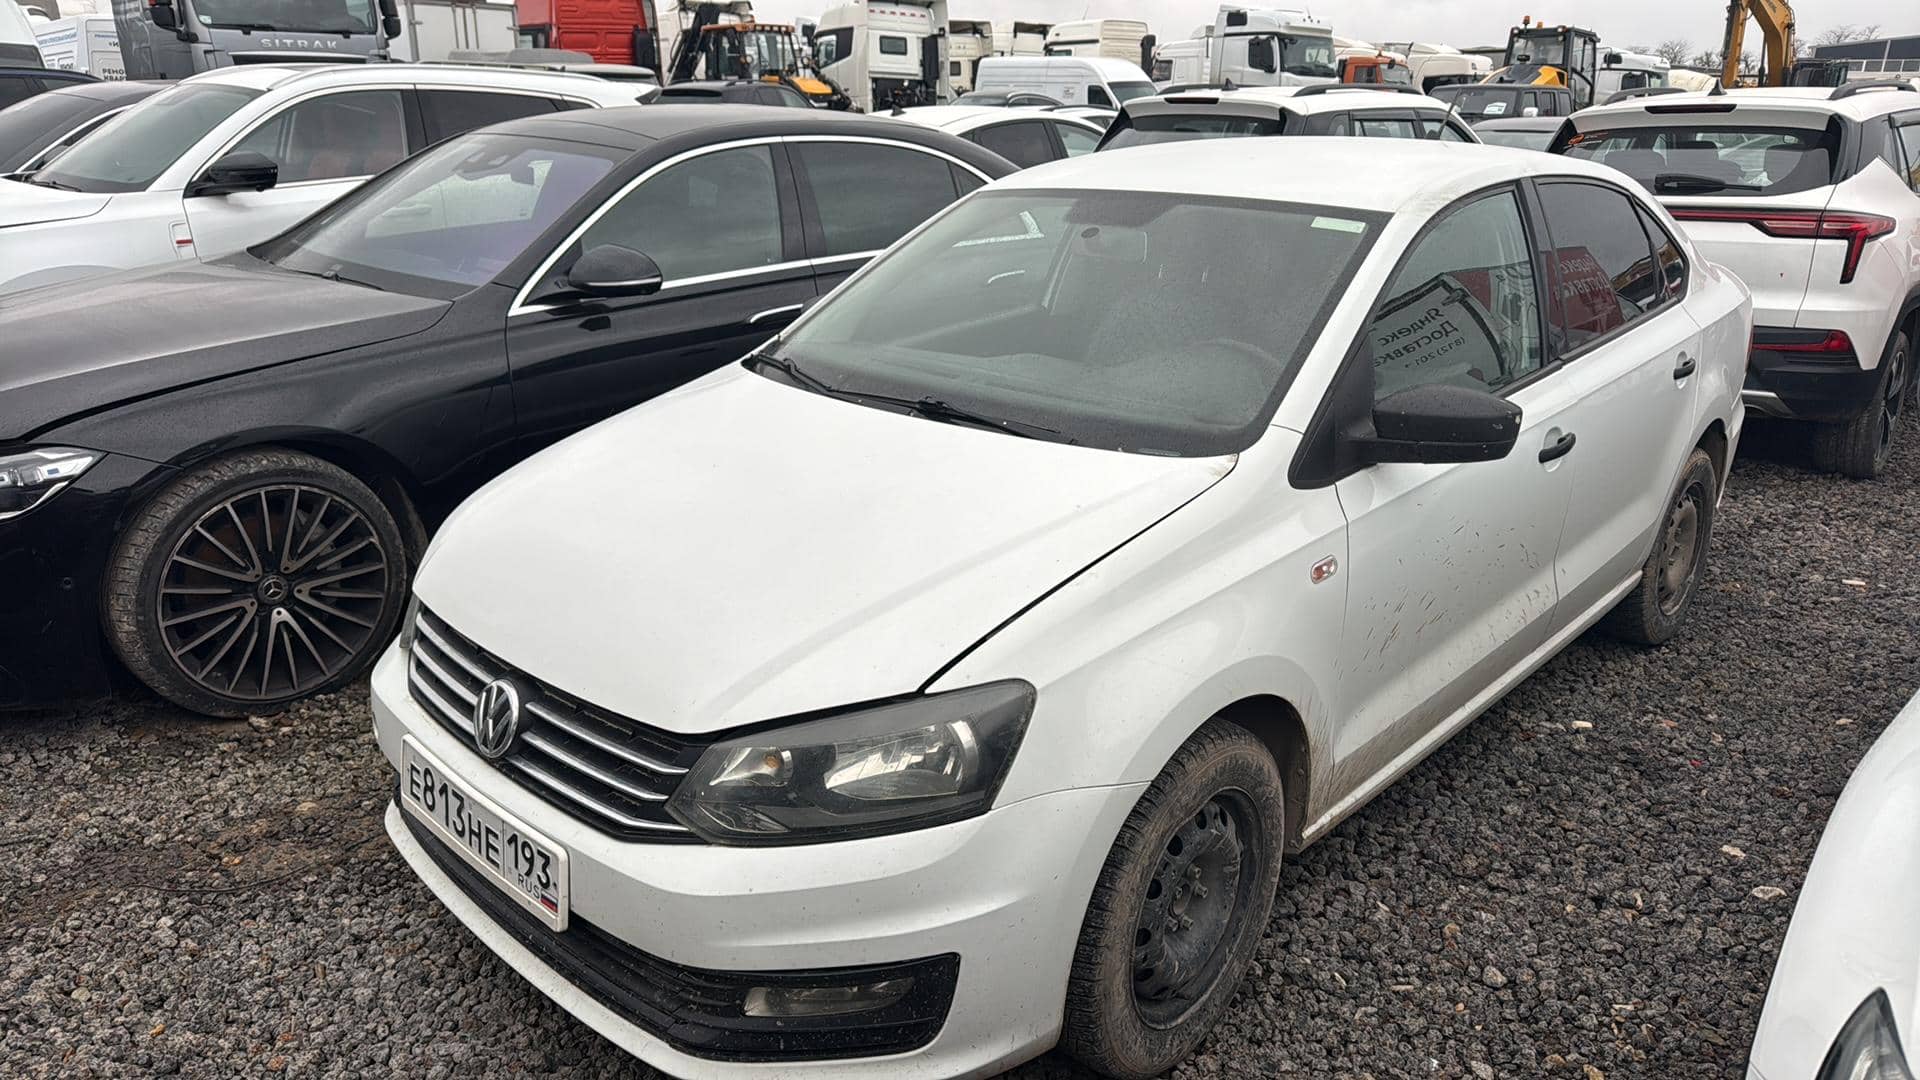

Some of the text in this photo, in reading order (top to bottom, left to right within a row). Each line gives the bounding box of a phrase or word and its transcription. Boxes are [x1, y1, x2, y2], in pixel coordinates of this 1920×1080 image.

[260, 38, 337, 49] SITRAK
[507, 833, 551, 889] 193
[518, 874, 541, 899] RUS
